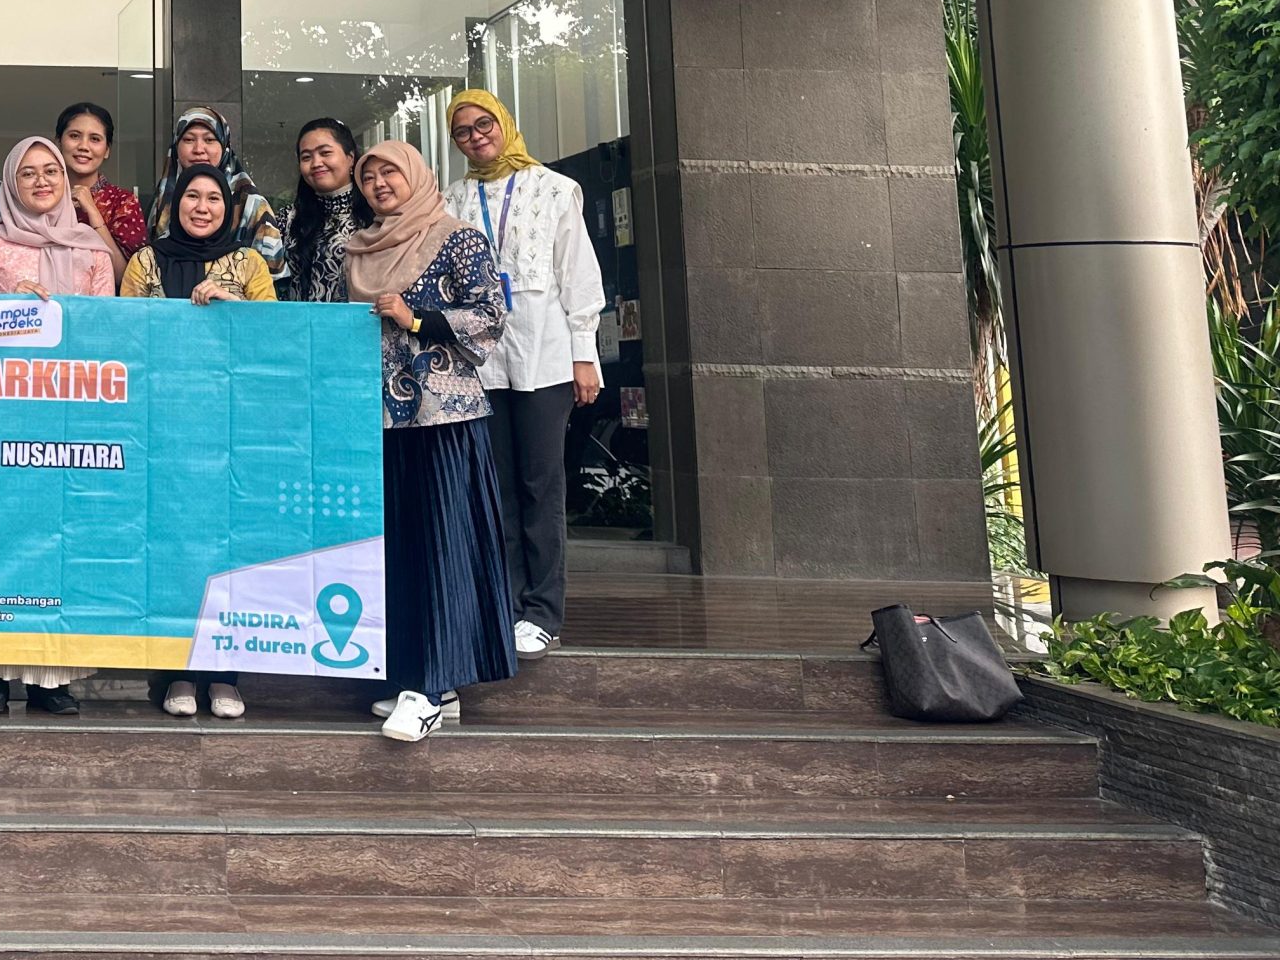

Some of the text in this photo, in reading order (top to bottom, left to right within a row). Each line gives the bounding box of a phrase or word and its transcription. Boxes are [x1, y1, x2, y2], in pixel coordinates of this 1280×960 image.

[1, 443, 124, 470] NUSANTARA
[219, 611, 300, 630] UNDIRA
[212, 635, 307, 655] TJ. duren
